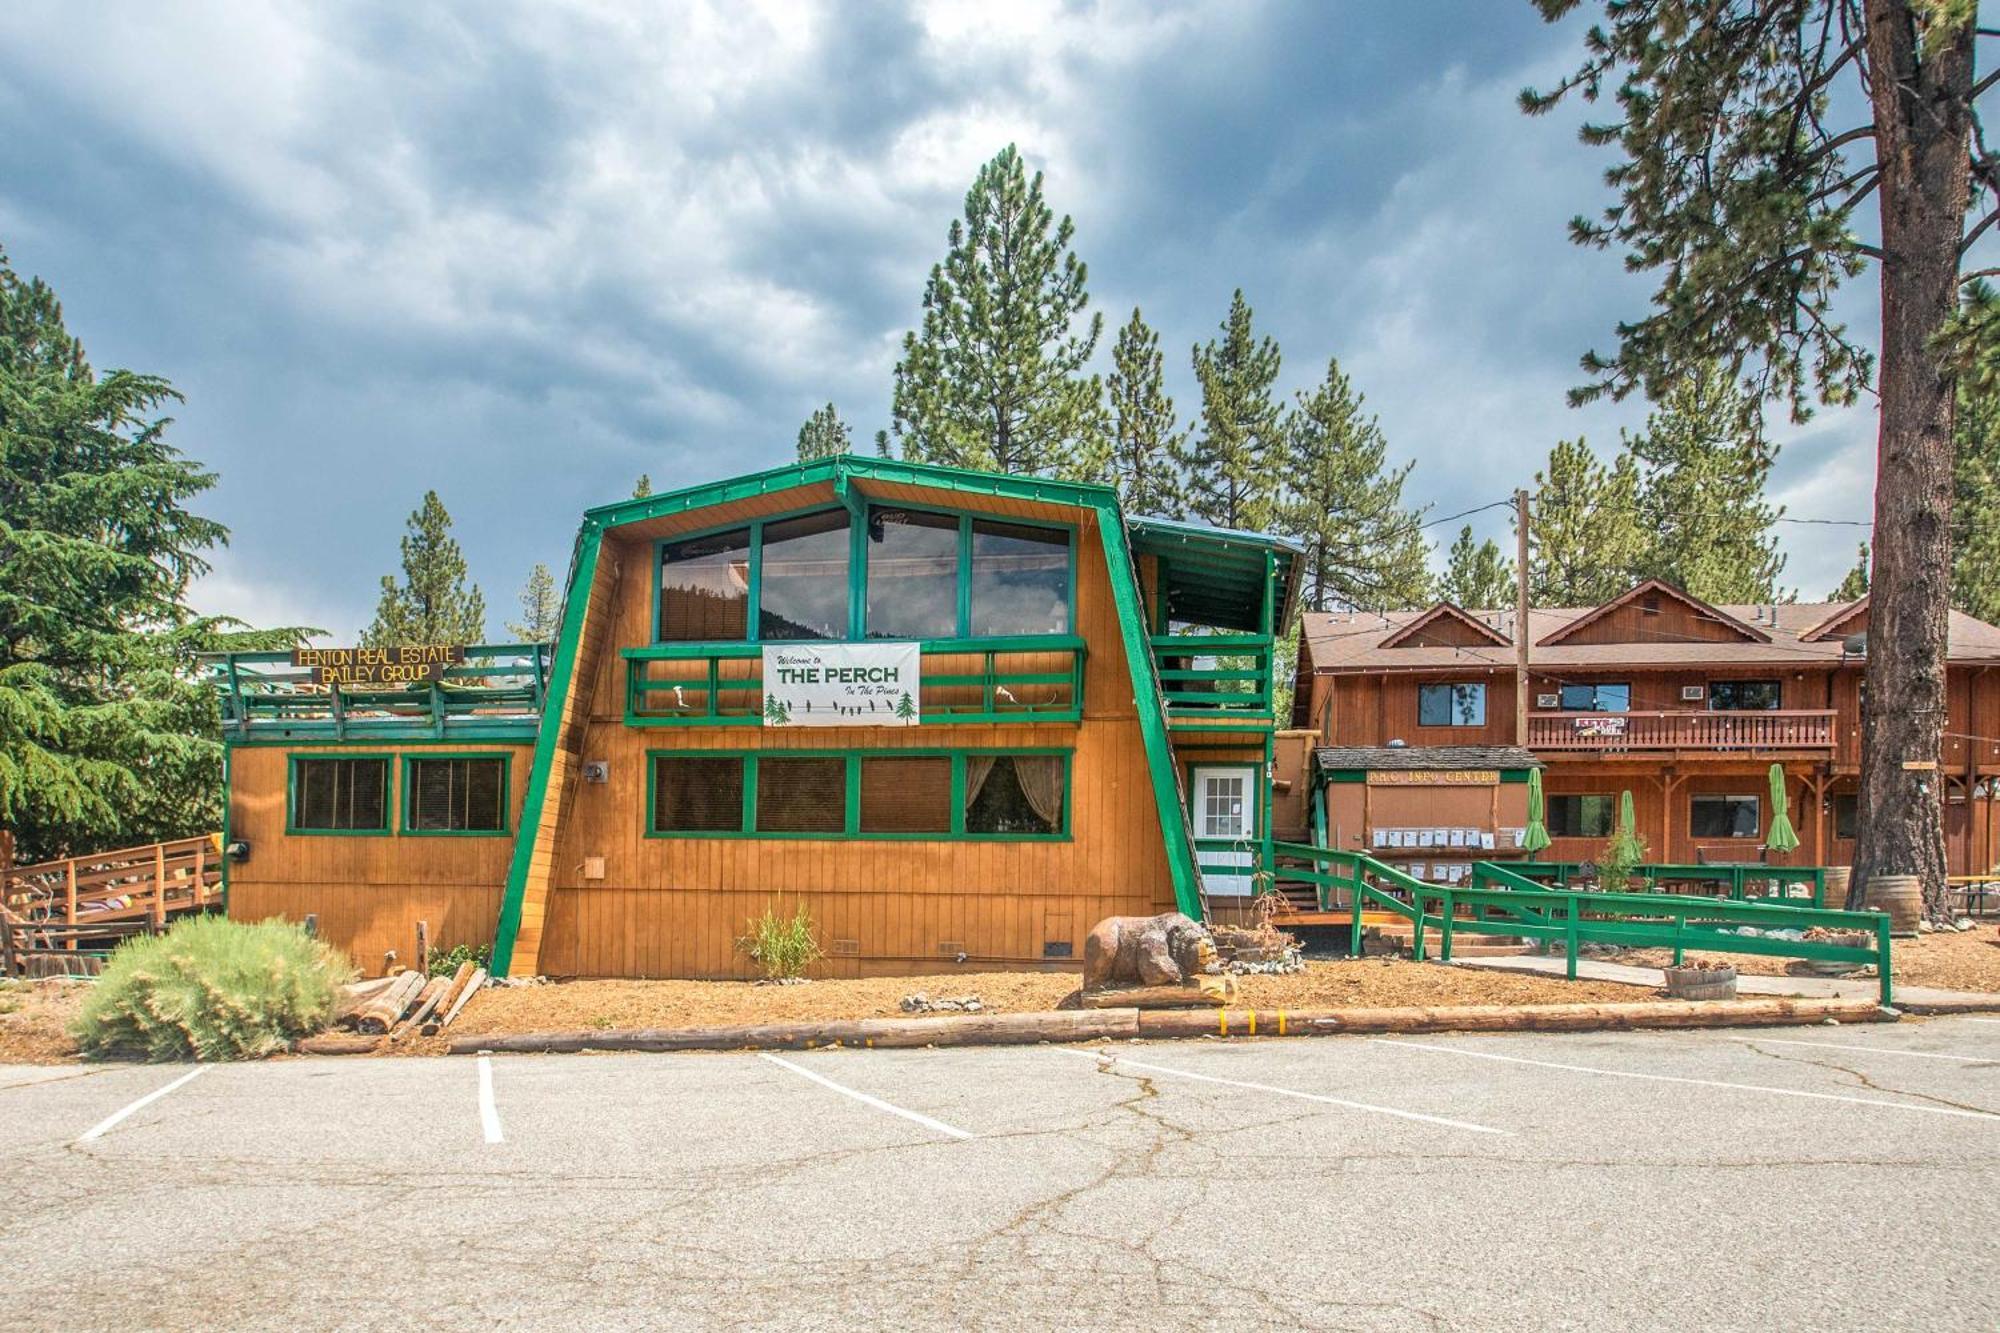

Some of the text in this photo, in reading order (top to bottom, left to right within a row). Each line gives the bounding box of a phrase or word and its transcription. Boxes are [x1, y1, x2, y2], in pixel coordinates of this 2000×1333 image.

[299, 646, 455, 666] FENTON REAL ESTATE
[777, 655, 821, 665] Welcome to
[322, 665, 430, 683] BAILEY GROUP
[777, 667, 899, 684] THE PERCH
[845, 685, 900, 696] In The Pines
[1408, 771, 1439, 782] INFO
[1445, 771, 1497, 782] CENTER
